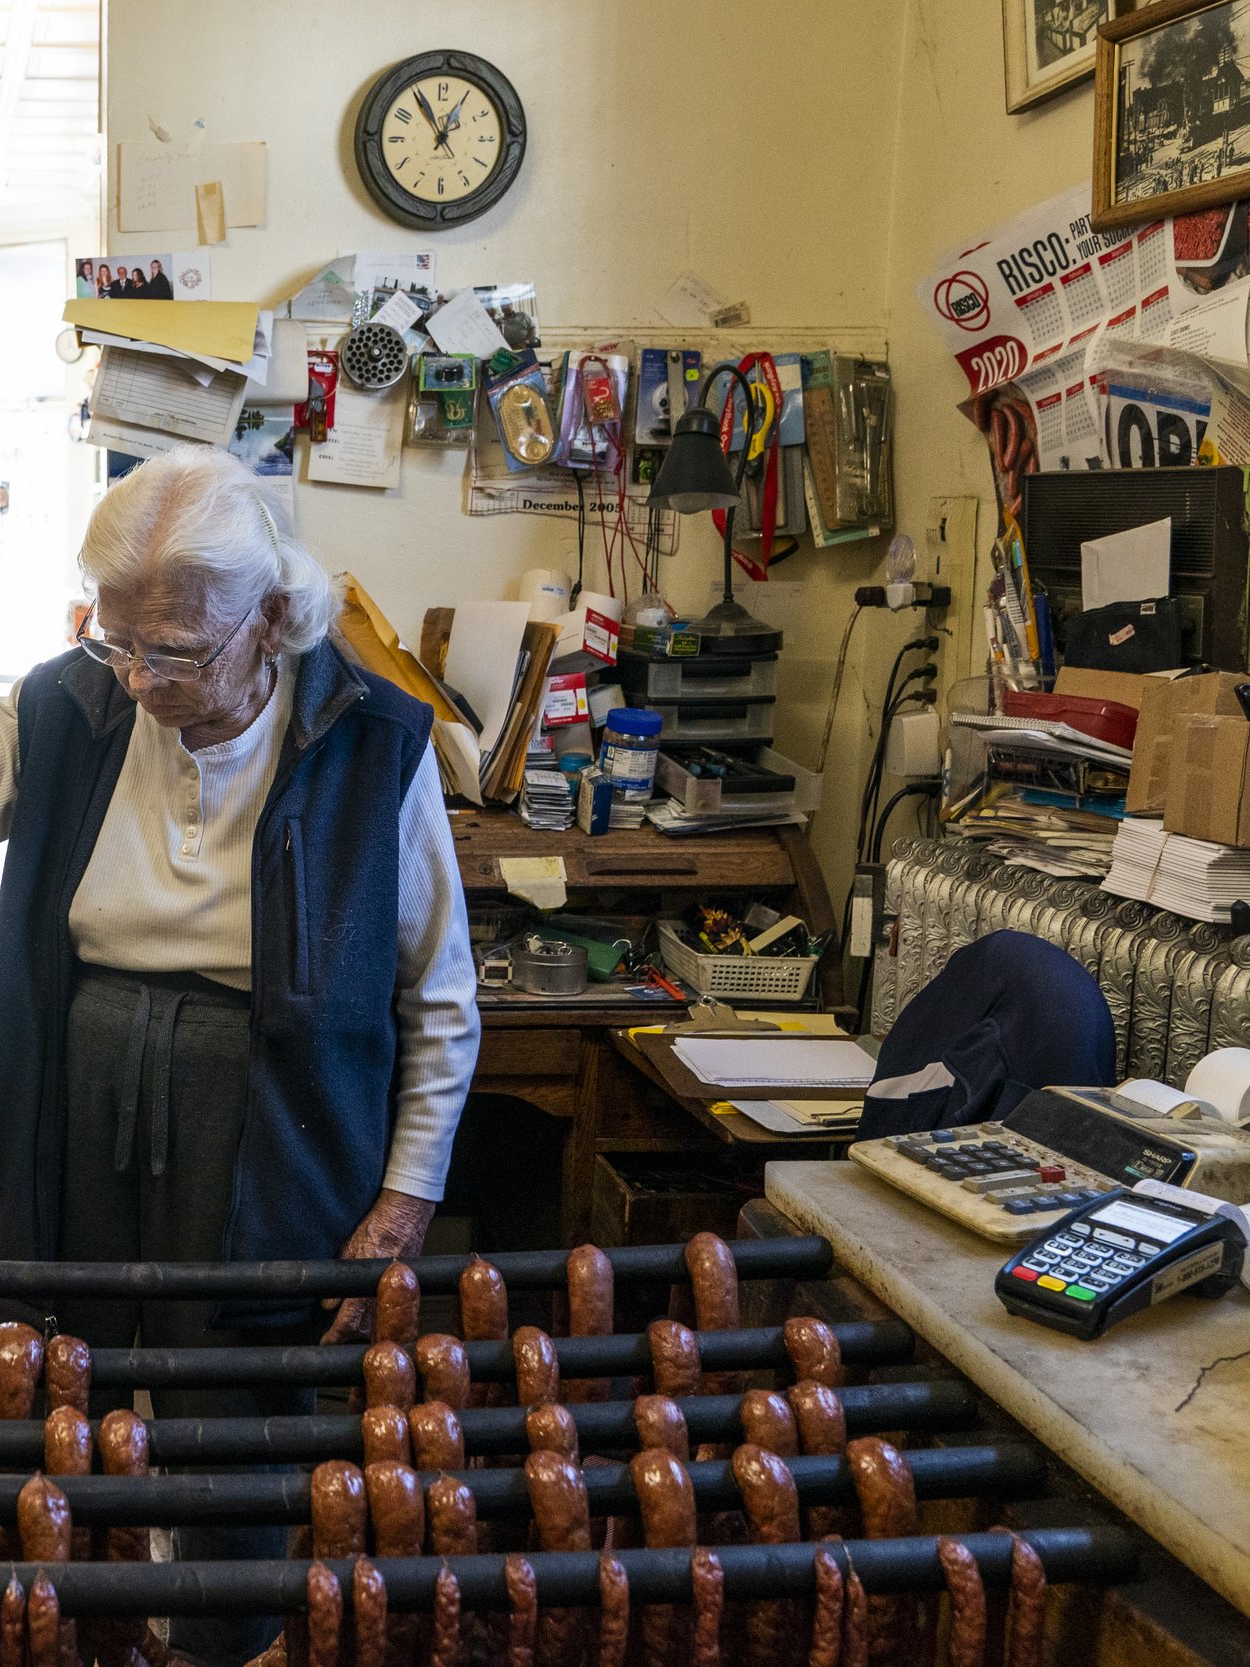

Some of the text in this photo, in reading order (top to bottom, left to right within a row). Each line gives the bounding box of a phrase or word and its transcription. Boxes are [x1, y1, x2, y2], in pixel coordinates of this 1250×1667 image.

[437, 82, 448, 102] 12
[437, 176, 445, 196] 6
[1076, 235, 1103, 261] YOUR
[996, 232, 1078, 297] RISCO:
[950, 292, 982, 318] RISCO
[971, 341, 1019, 393] 2020
[1143, 1149, 1172, 1164] SHARP
